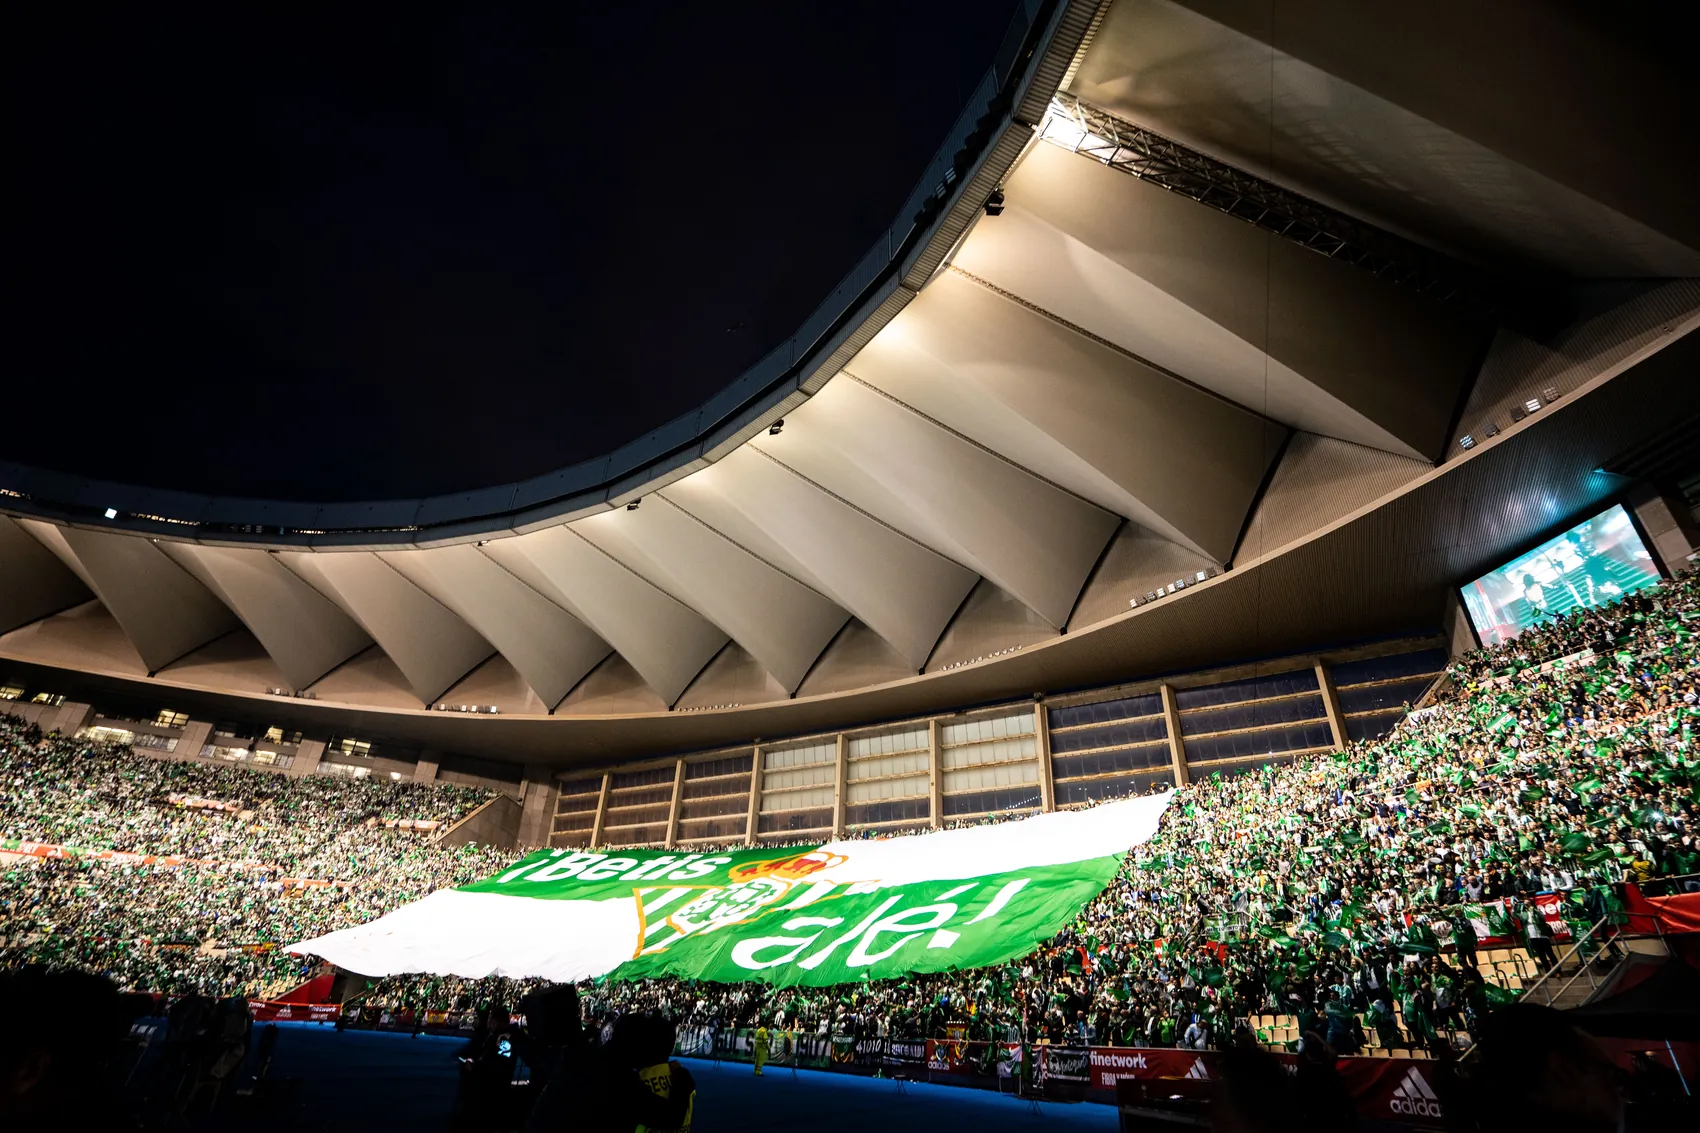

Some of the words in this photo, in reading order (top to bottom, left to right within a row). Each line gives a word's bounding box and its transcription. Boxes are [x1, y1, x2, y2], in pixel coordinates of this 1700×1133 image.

[496, 851, 733, 884] ¡Betis
[731, 878, 1032, 970] alé!
[1089, 1051, 1148, 1069] finetwork
[1389, 1098, 1443, 1118] adida
